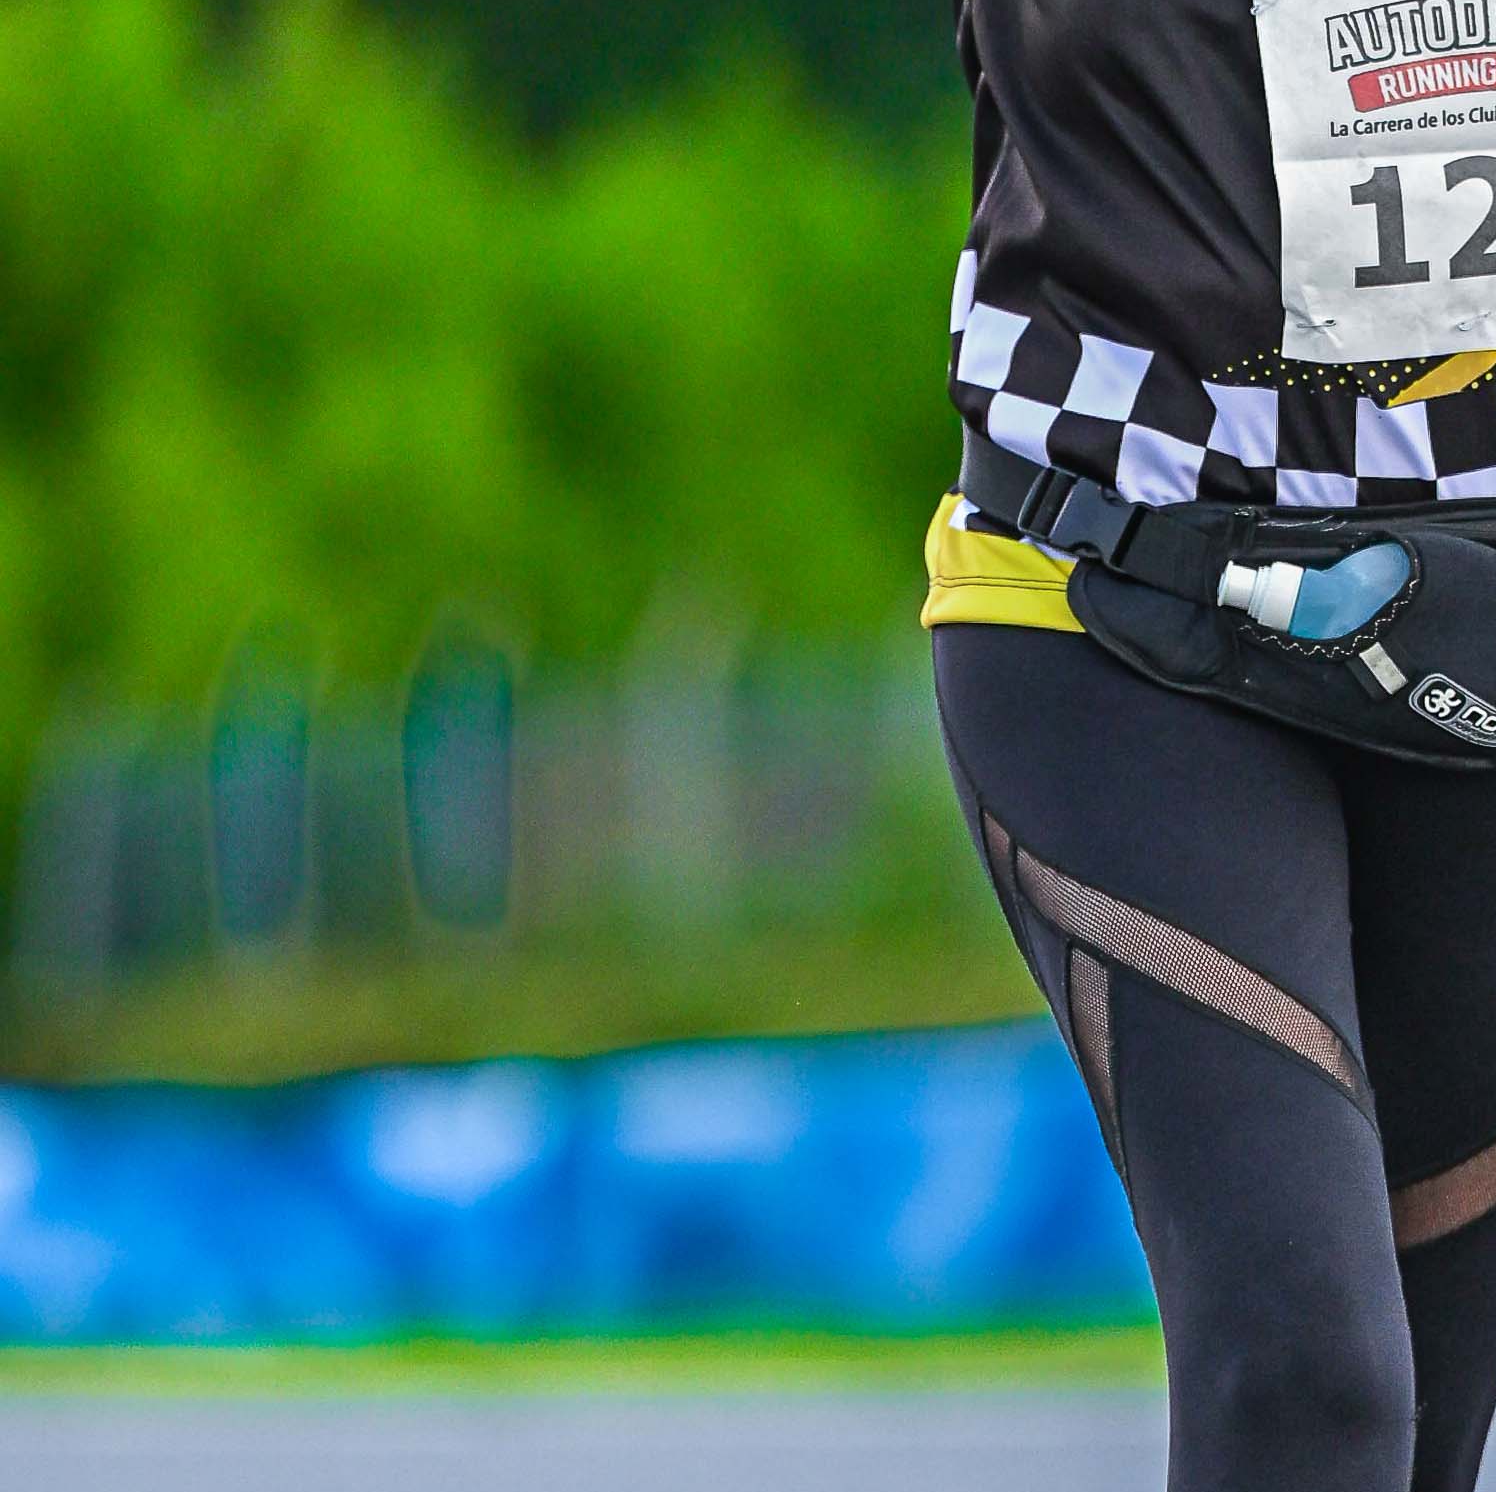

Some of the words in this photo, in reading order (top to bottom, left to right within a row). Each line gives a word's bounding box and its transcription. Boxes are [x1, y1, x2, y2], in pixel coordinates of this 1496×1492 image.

[1330, 121, 1349, 138] La
[1352, 116, 1414, 136] Carrera
[1417, 108, 1438, 128] de
[1442, 106, 1465, 126] los
